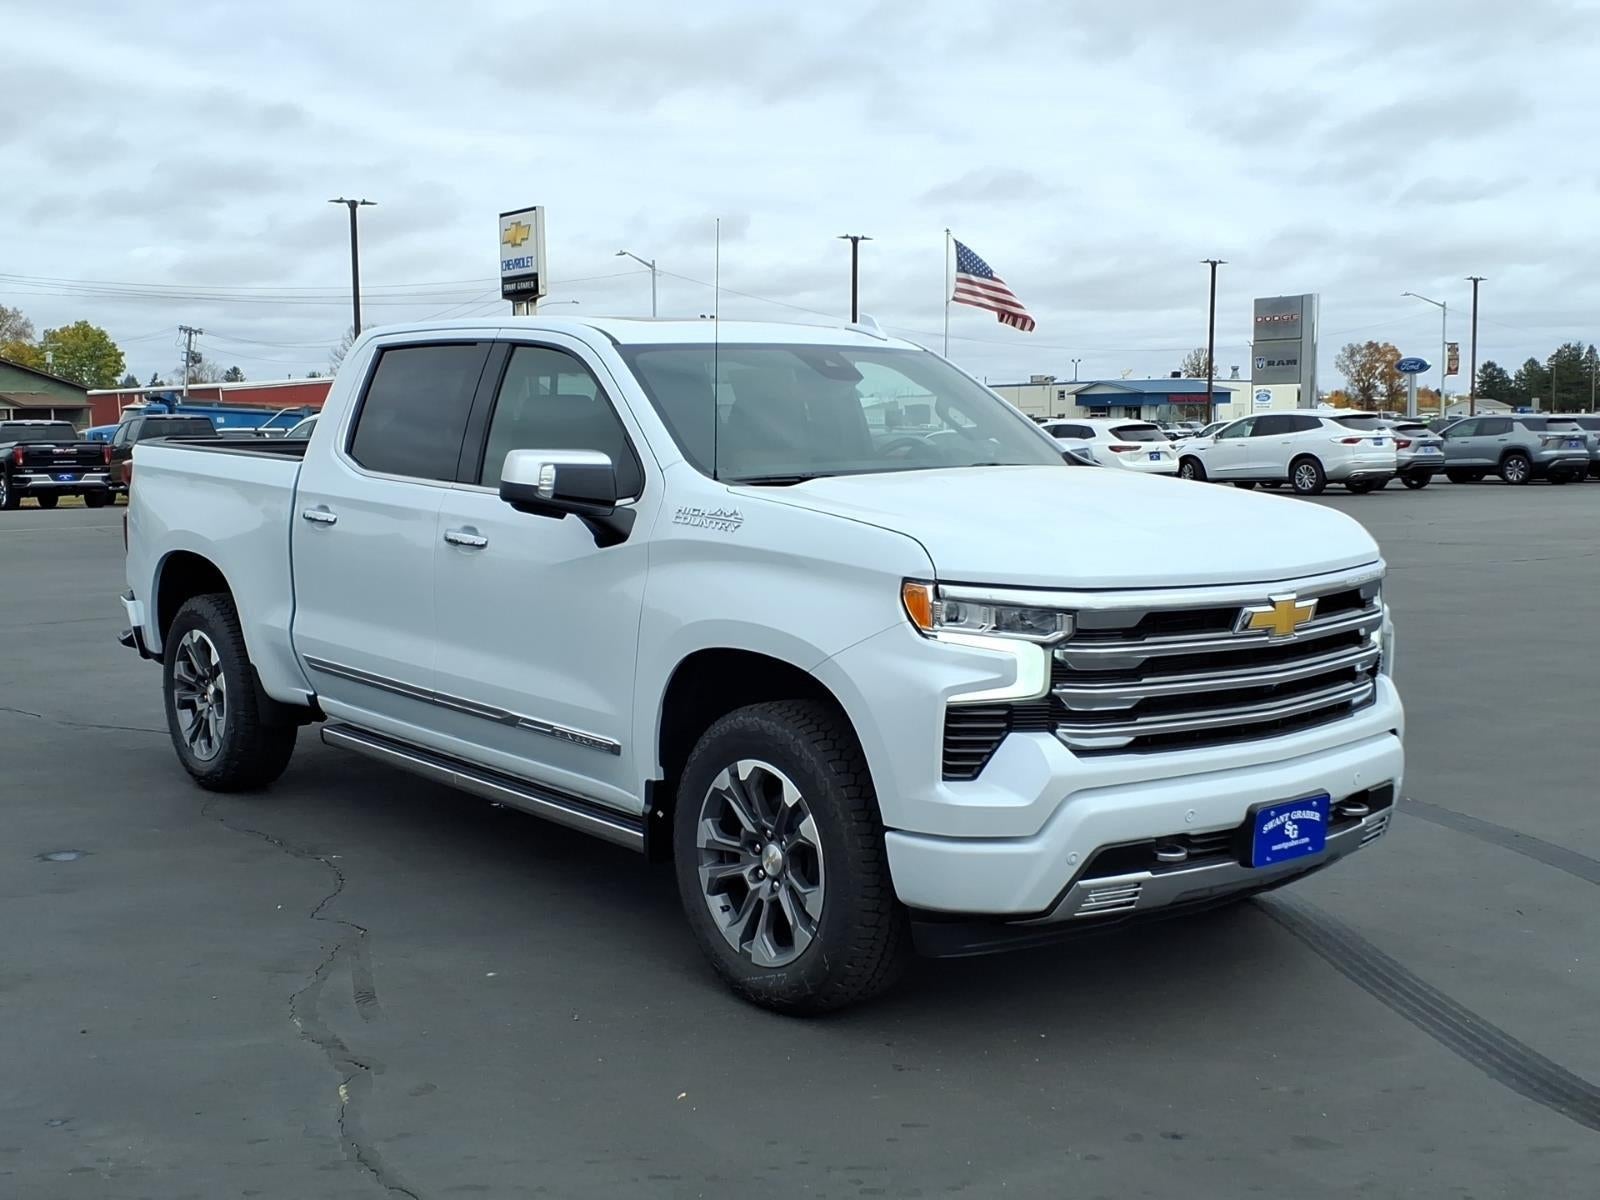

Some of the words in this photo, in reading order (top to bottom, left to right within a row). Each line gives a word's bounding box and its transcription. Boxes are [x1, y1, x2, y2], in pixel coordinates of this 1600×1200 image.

[501, 256, 534, 271] CHEVROLET
[1256, 313, 1300, 322] DODGE
[1267, 359, 1297, 367] RAM
[1400, 360, 1421, 370] Ford
[674, 506, 706, 518] HIGH
[672, 515, 741, 532] COUNTRY
[1262, 813, 1290, 834] SWANT
[1291, 810, 1321, 821] GRABER
[1284, 820, 1299, 839] SG
